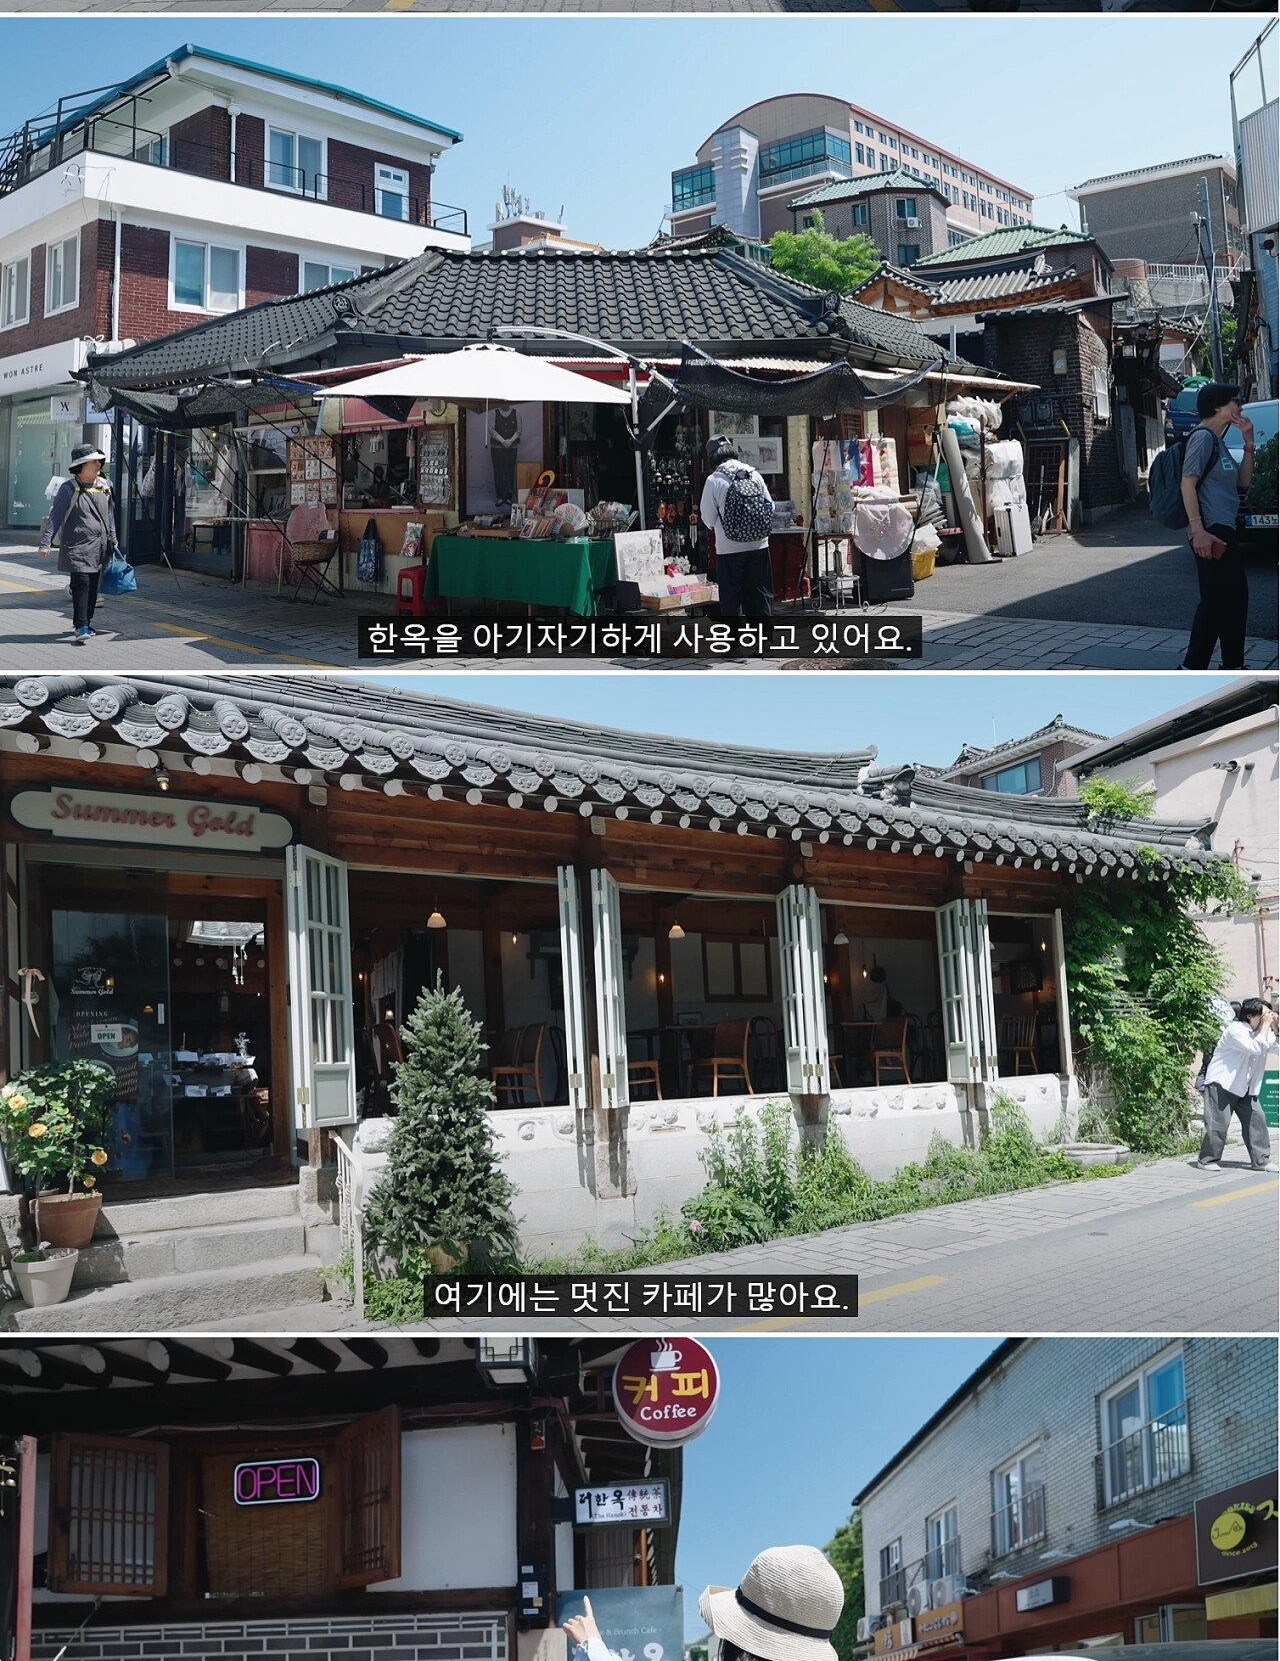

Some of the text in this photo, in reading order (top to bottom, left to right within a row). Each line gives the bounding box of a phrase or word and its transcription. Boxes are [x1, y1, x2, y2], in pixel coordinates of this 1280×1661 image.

[3, 369, 18, 379] WON
[51, 793, 255, 838] Summer Gold
[97, 1032, 116, 1041] OPEN
[621, 1371, 709, 1405] 커피
[639, 1404, 697, 1422] Coffee
[238, 1464, 316, 1500] OPEN
[628, 1503, 663, 1517] 전통차
[613, 1627, 639, 1635] Brunch
